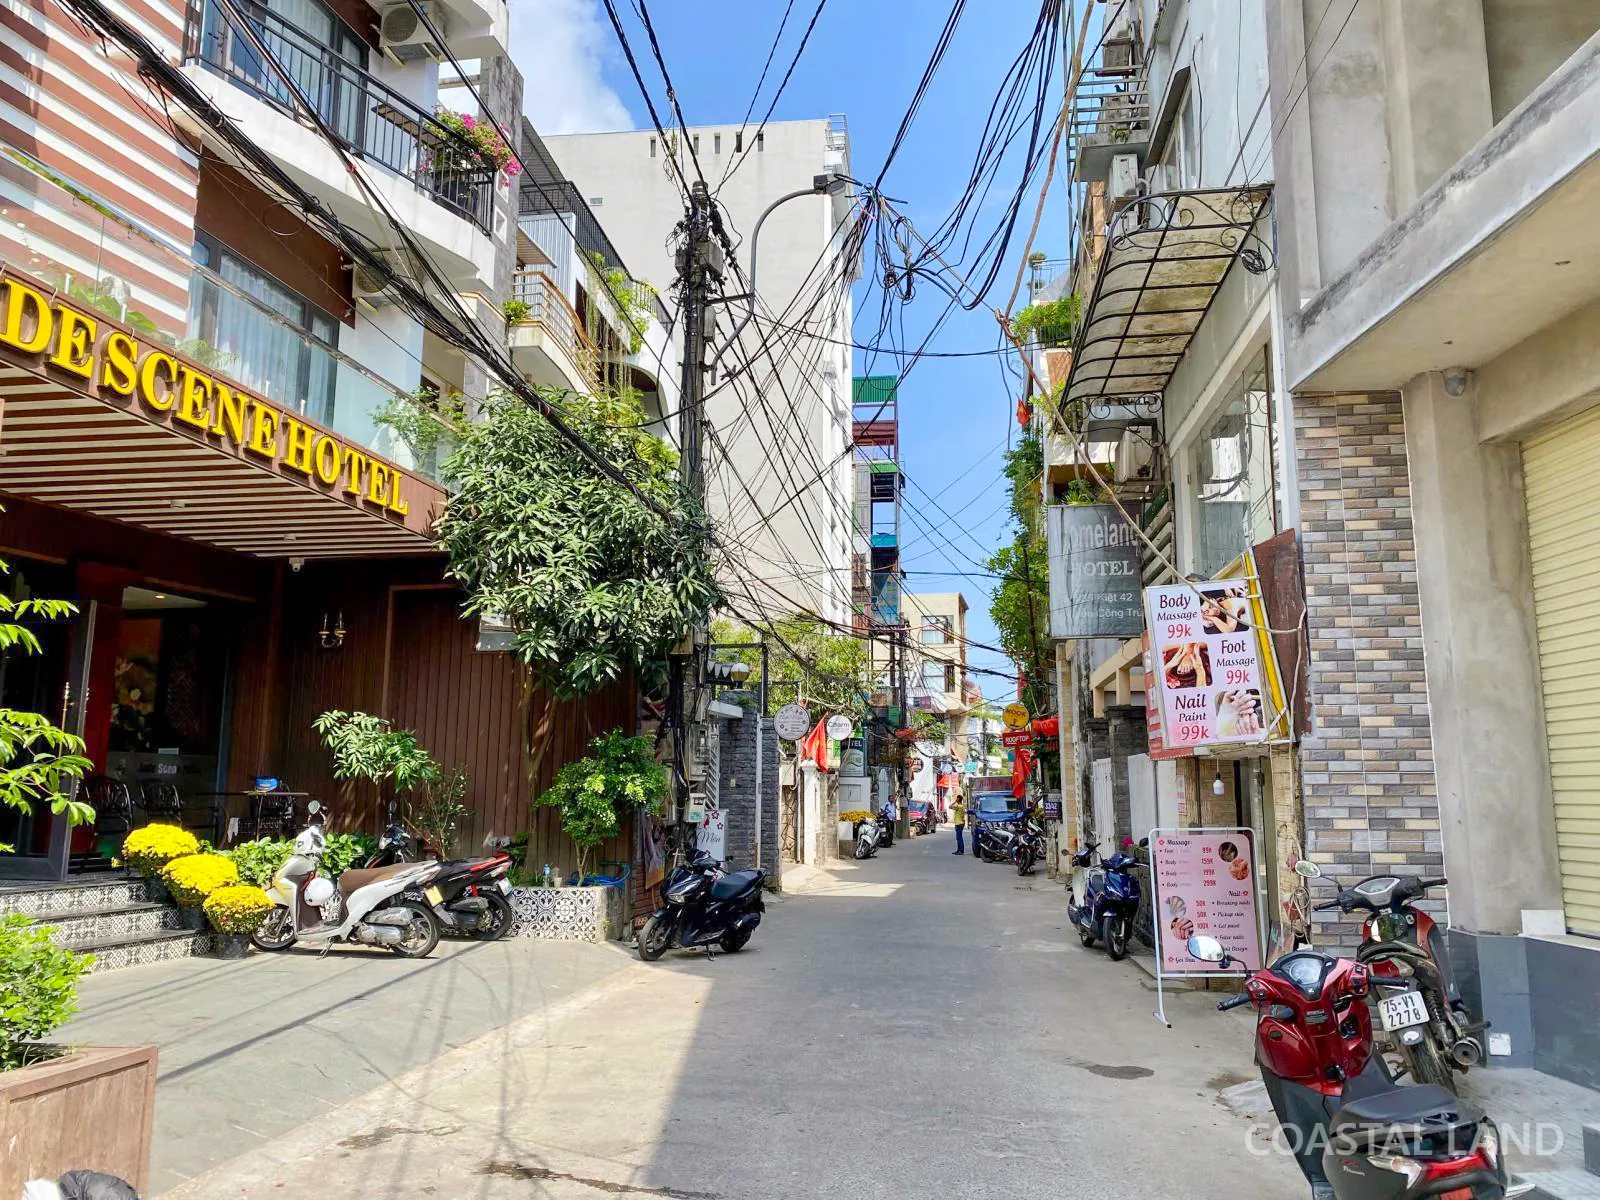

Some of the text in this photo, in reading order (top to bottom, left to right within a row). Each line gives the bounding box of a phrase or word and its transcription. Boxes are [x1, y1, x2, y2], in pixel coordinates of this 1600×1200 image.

[284, 415, 408, 516] HOTEL
[1159, 594, 1191, 609] Body
[1157, 611, 1198, 622] Massage
[1167, 624, 1191, 639] 99k
[1221, 640, 1246, 654] Foot
[1216, 657, 1255, 668] Massage
[1226, 669, 1250, 684] 99k
[1175, 694, 1207, 710] Nail
[1178, 711, 1207, 722] Paint
[1181, 725, 1209, 741] 99k
[1383, 995, 1415, 1013] 75-V1
[1388, 1008, 1421, 1027] 2278
